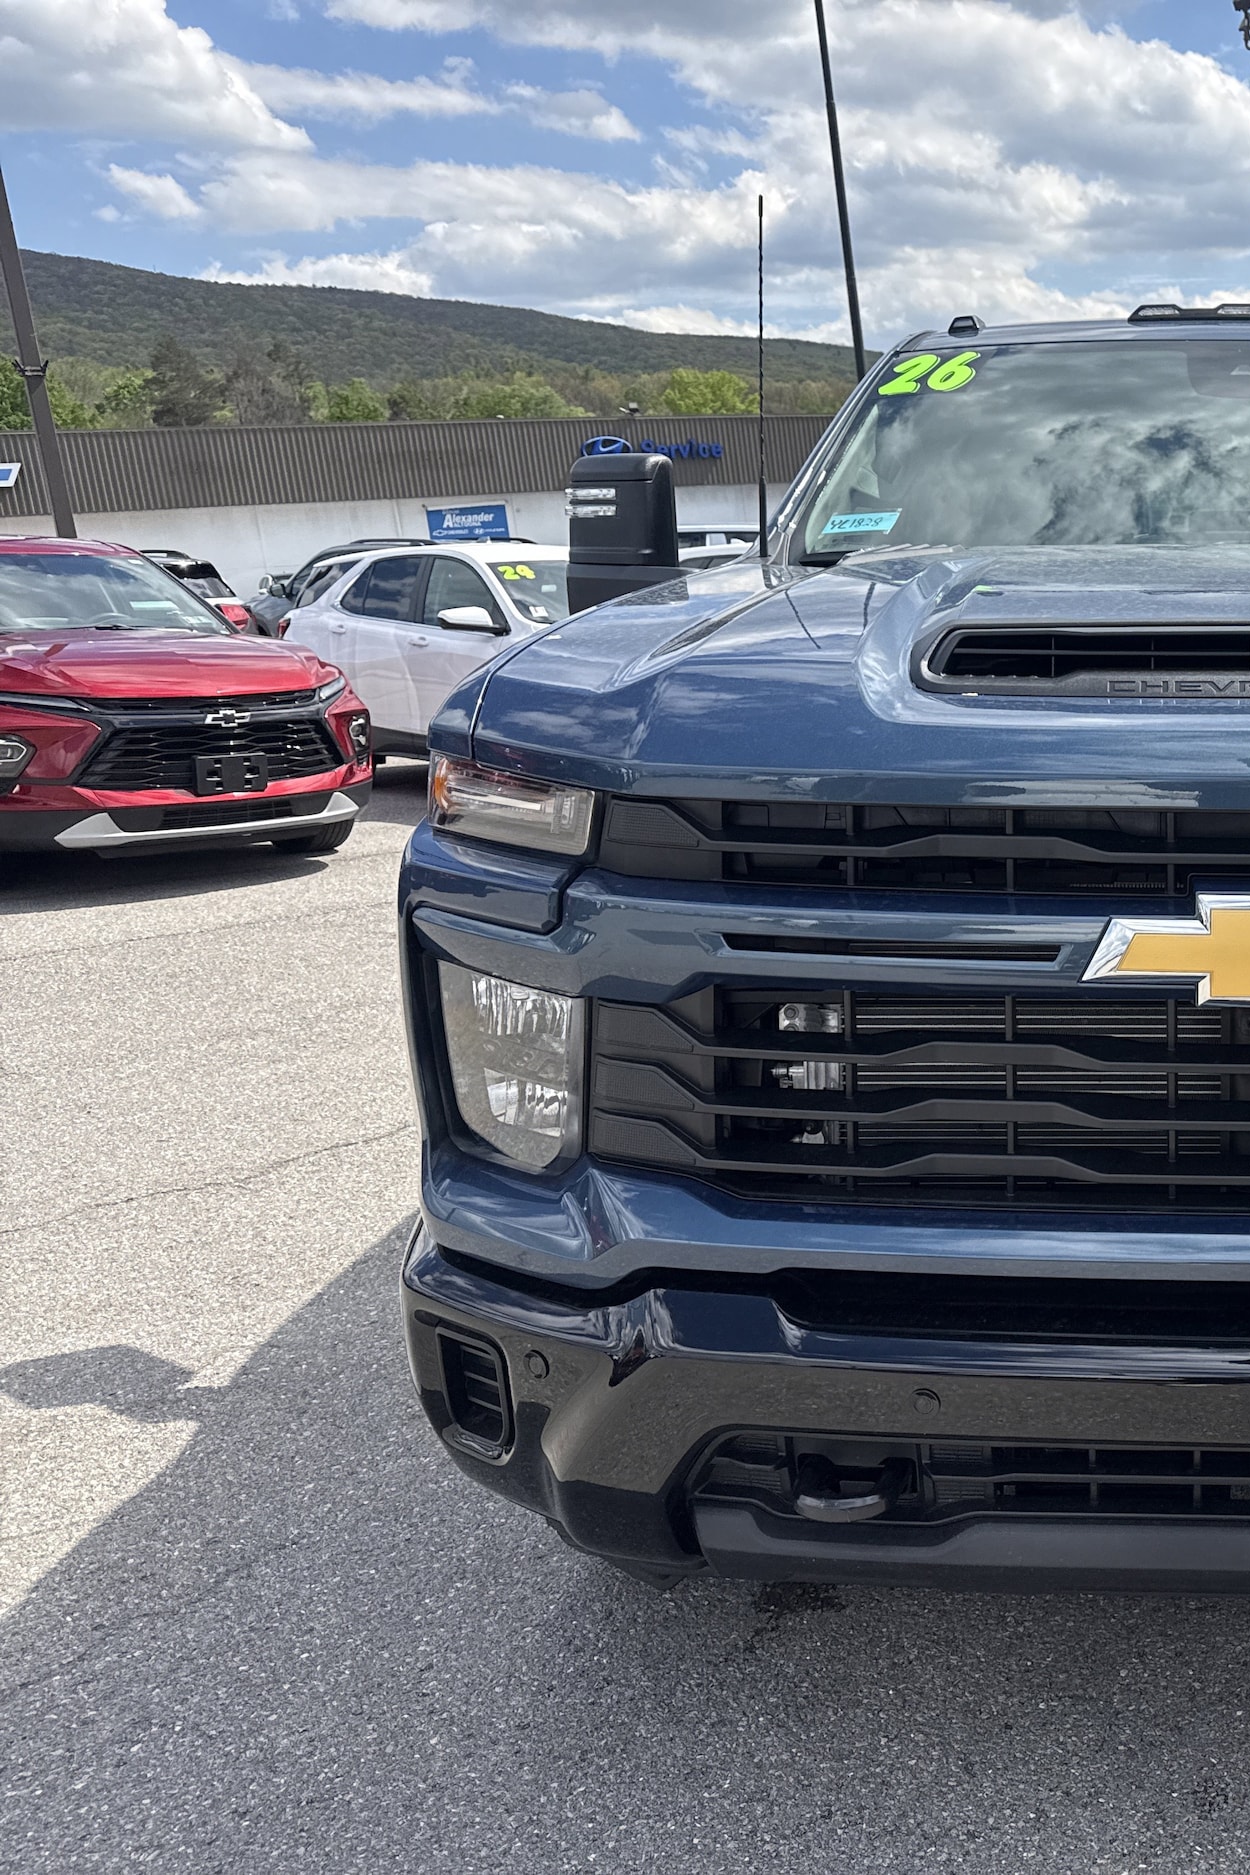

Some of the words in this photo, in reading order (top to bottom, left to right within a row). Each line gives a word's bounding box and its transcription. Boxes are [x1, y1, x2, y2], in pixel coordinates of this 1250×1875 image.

[877, 351, 981, 395] 26
[640, 438, 724, 458] Service
[442, 511, 494, 529] Alexander
